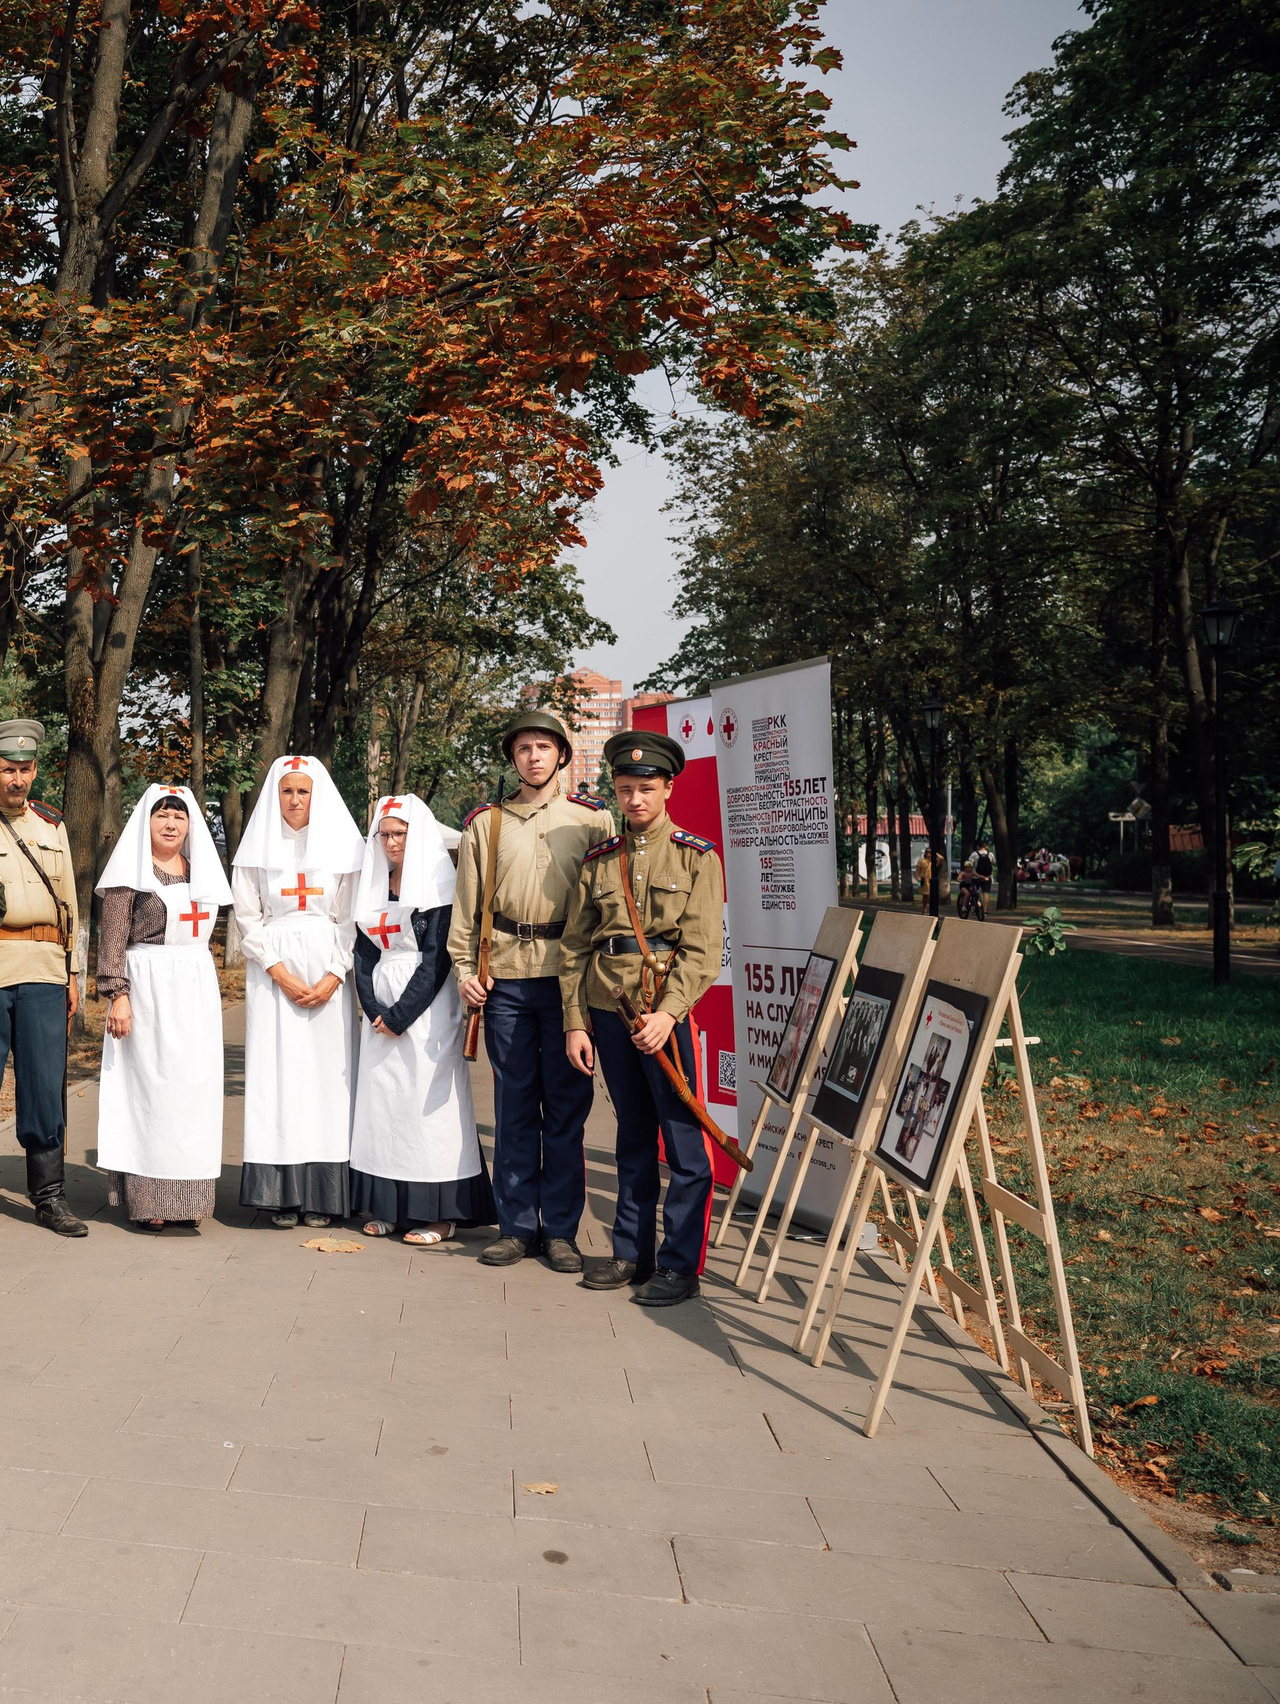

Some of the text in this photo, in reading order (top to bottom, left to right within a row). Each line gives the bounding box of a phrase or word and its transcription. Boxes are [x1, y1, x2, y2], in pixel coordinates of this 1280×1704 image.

[767, 714, 787, 730] РКК
[753, 735, 788, 752] КРАСНЫЙ
[753, 751, 772, 762] КРЕСТ
[754, 760, 790, 769] ДОБРОВОЛЬНОСТЬ
[755, 772, 791, 784] ПРИНЦИПЫ
[726, 785, 759, 794] НЕЗАВИСИМОСТЬ
[765, 782, 783, 790] СЛУЖБЕ
[783, 779, 801, 797] 155
[802, 776, 827, 795] ЛЕТ
[726, 789, 785, 806] ДОБРОВОЛЬНОСТЬ
[758, 796, 828, 811] БЕСПРИСТРАСТНОСТЬ
[728, 811, 771, 823] НЕЙТРАЛЬНОСТЬ
[771, 806, 828, 824] ПРИНЦИПЫ
[728, 822, 829, 836] ГУМАННОСТЬ РКК ДОБРОВОЛЬНОСТЬ
[730, 835, 799, 849] УНИВЕРСАЛЬНОСТЬ
[807, 831, 829, 839] СЛУЖБЕ
[760, 857, 773, 869] 155
[760, 872, 773, 882] ЛЕТ
[761, 884, 796, 893] НА СЛУЖБЕ
[761, 900, 797, 911] ЕДИНСТВО
[744, 962, 775, 994] 155
[746, 1000, 793, 1024] НА СЛУ
[748, 1052, 776, 1069] И МИ
